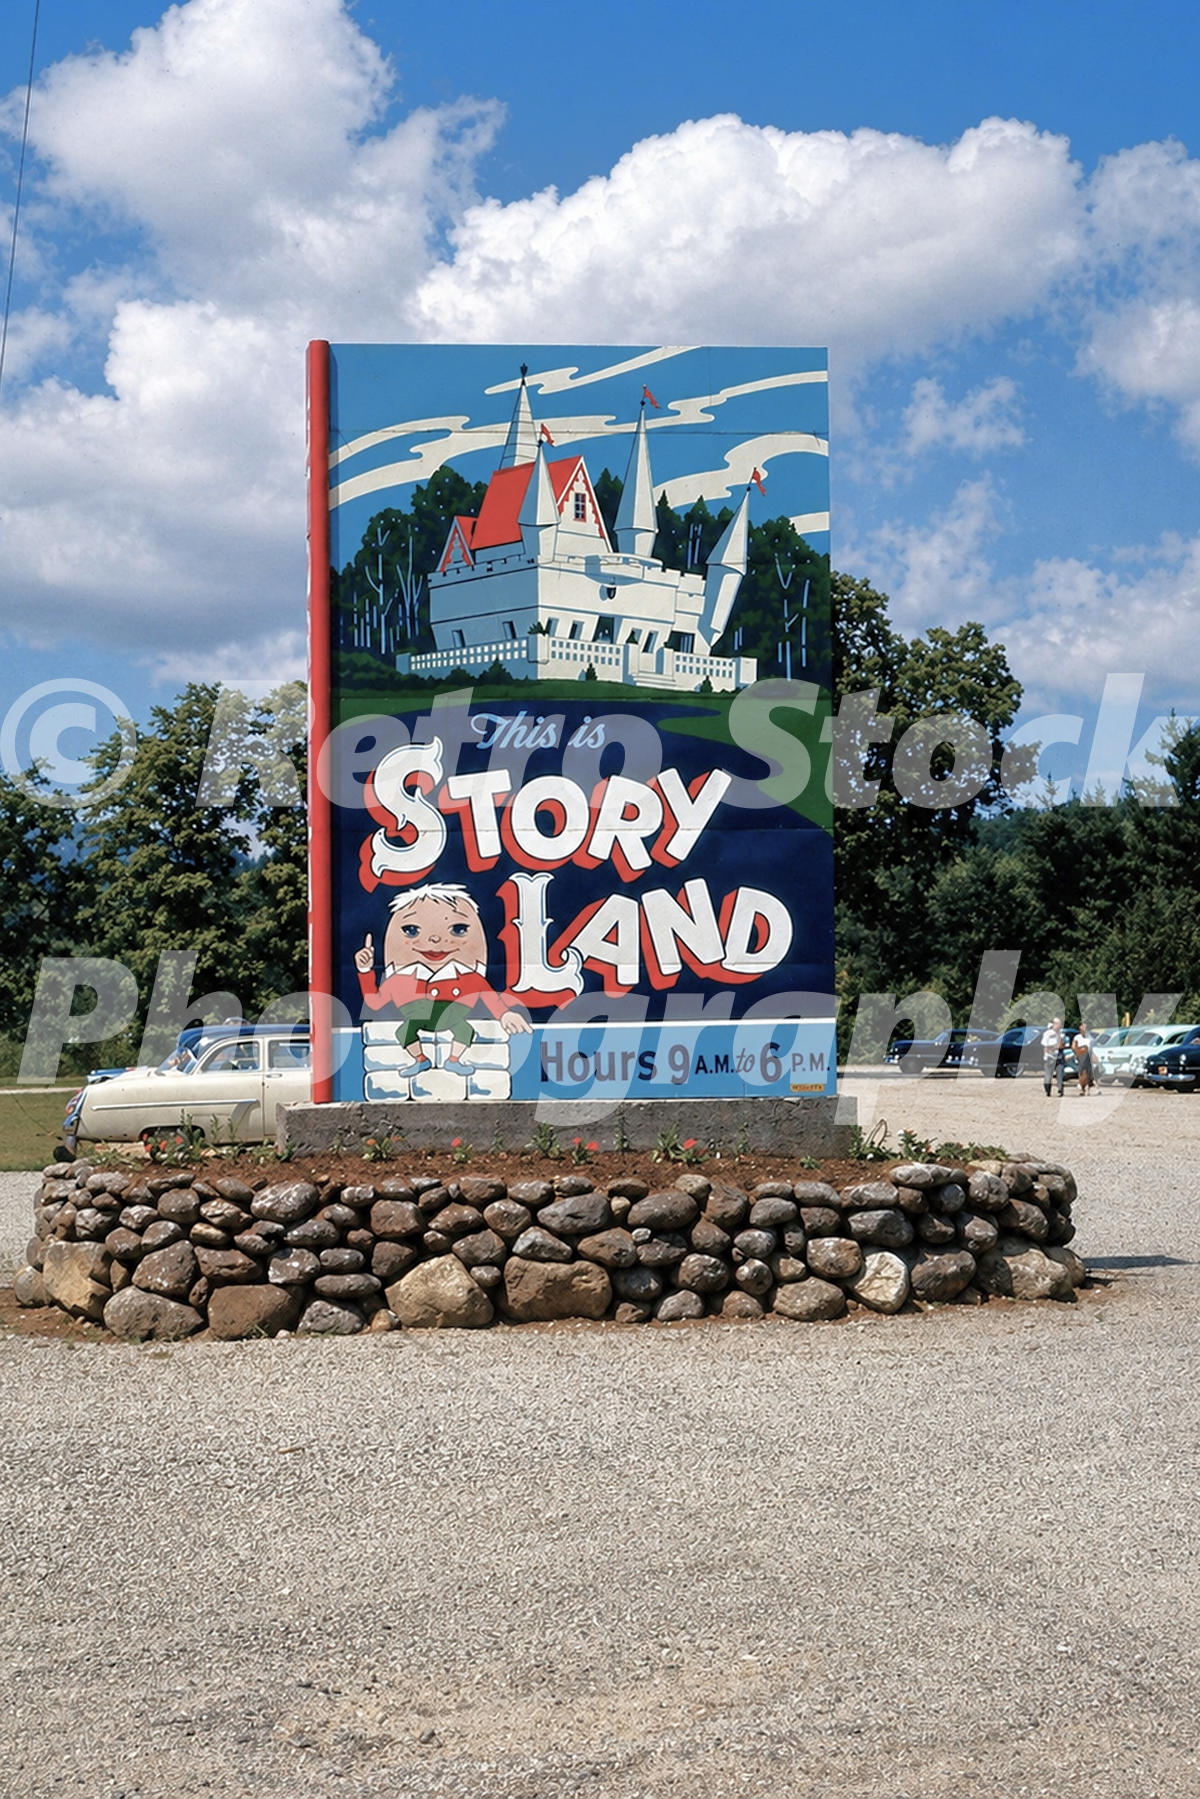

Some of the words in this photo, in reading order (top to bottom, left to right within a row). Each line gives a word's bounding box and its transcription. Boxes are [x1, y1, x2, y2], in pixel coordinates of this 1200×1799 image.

[471, 711, 556, 750] This
[567, 715, 606, 749] is
[365, 736, 733, 882] STORY
[503, 871, 793, 1000] LAND
[540, 1041, 656, 1083] Hours
[668, 1044, 690, 1085] 9
[695, 1054, 735, 1075] A.M.
[736, 1048, 755, 1073] to
[759, 1042, 782, 1083] 6
[792, 1052, 831, 1072] P.M.
